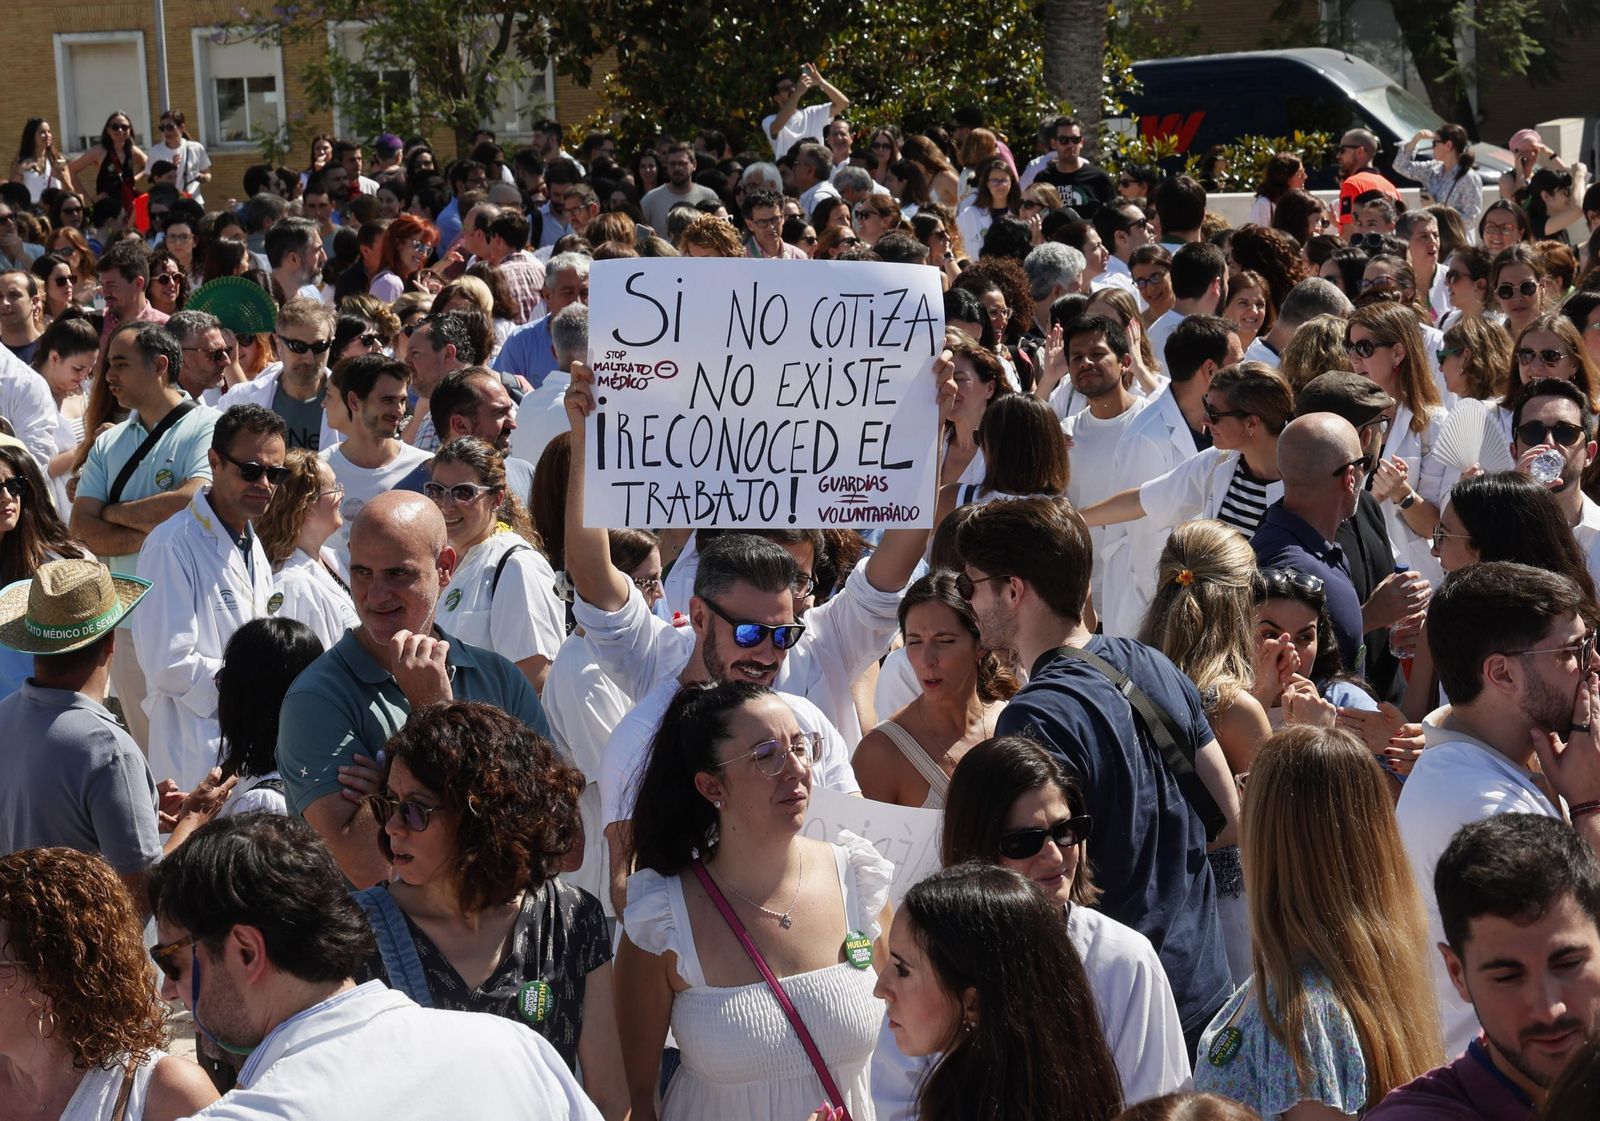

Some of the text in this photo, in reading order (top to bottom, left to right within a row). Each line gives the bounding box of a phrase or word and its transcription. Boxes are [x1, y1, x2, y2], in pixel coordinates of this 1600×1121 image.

[727, 282, 788, 350] NO
[593, 362, 652, 375] MALTRATO
[605, 351, 627, 361] STOP
[689, 355, 754, 411] NO
[859, 421, 913, 470] EL
[611, 477, 799, 526] TRABAJO!
[43, 628, 80, 639] MÉDICO
[82, 624, 95, 635] DE
[847, 939, 871, 949] HUELGA
[537, 984, 546, 1021] HUELGA
[1213, 1030, 1238, 1064] HUELGA
